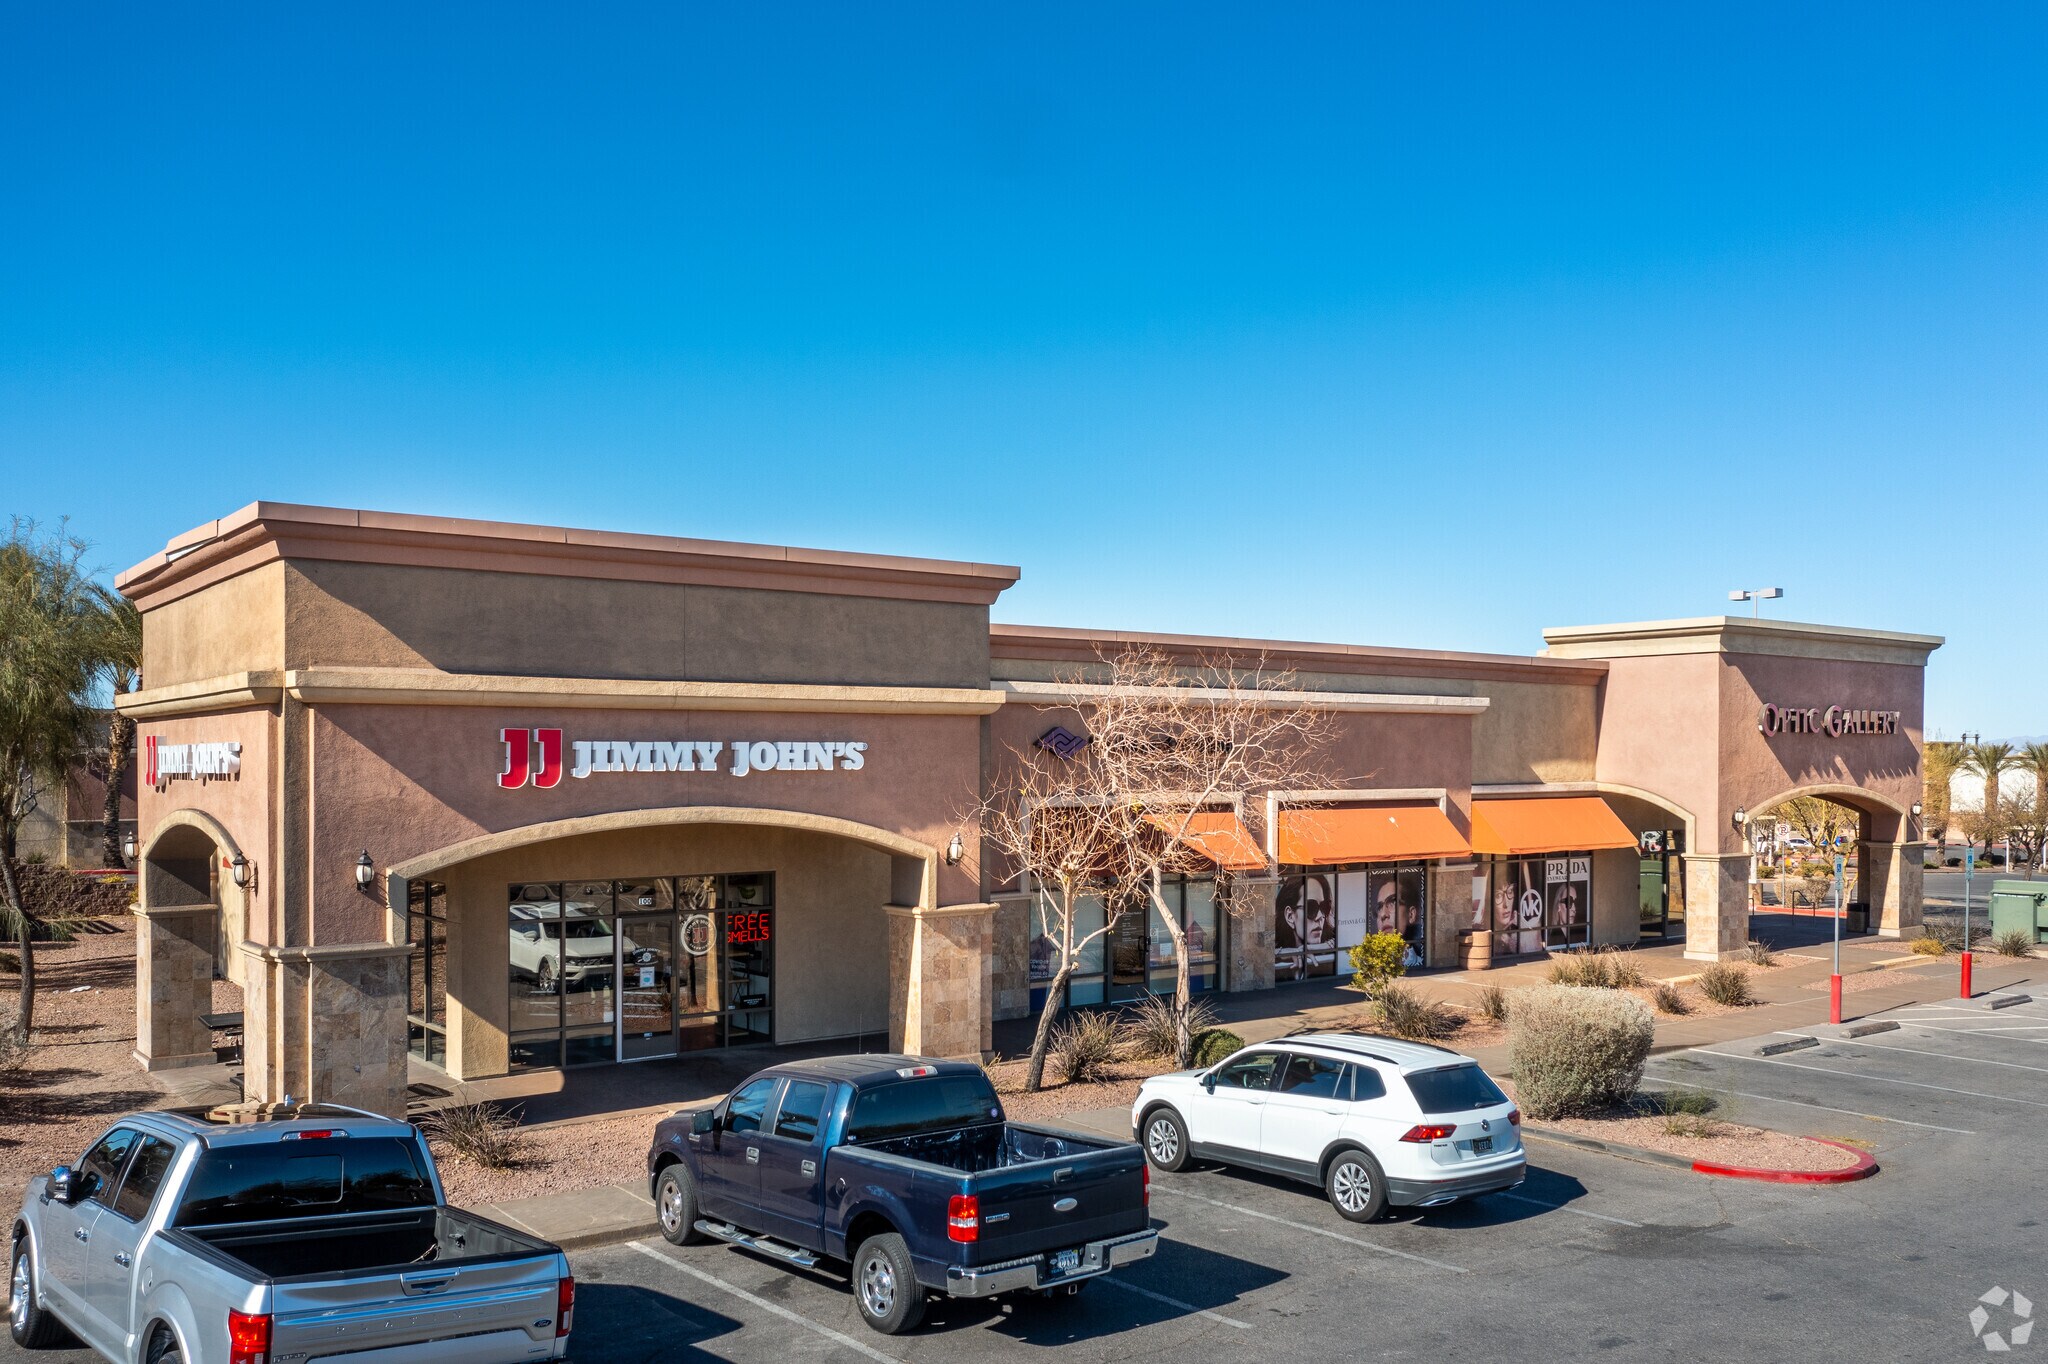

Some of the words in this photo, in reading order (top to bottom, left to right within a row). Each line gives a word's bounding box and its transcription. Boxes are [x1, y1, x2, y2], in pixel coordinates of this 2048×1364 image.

[1758, 703, 1820, 737] OPTIC
[1823, 705, 1900, 738] GALLERY
[497, 728, 562, 789] JJ
[570, 740, 723, 779] JIMMY
[730, 740, 866, 777] JOHN'S
